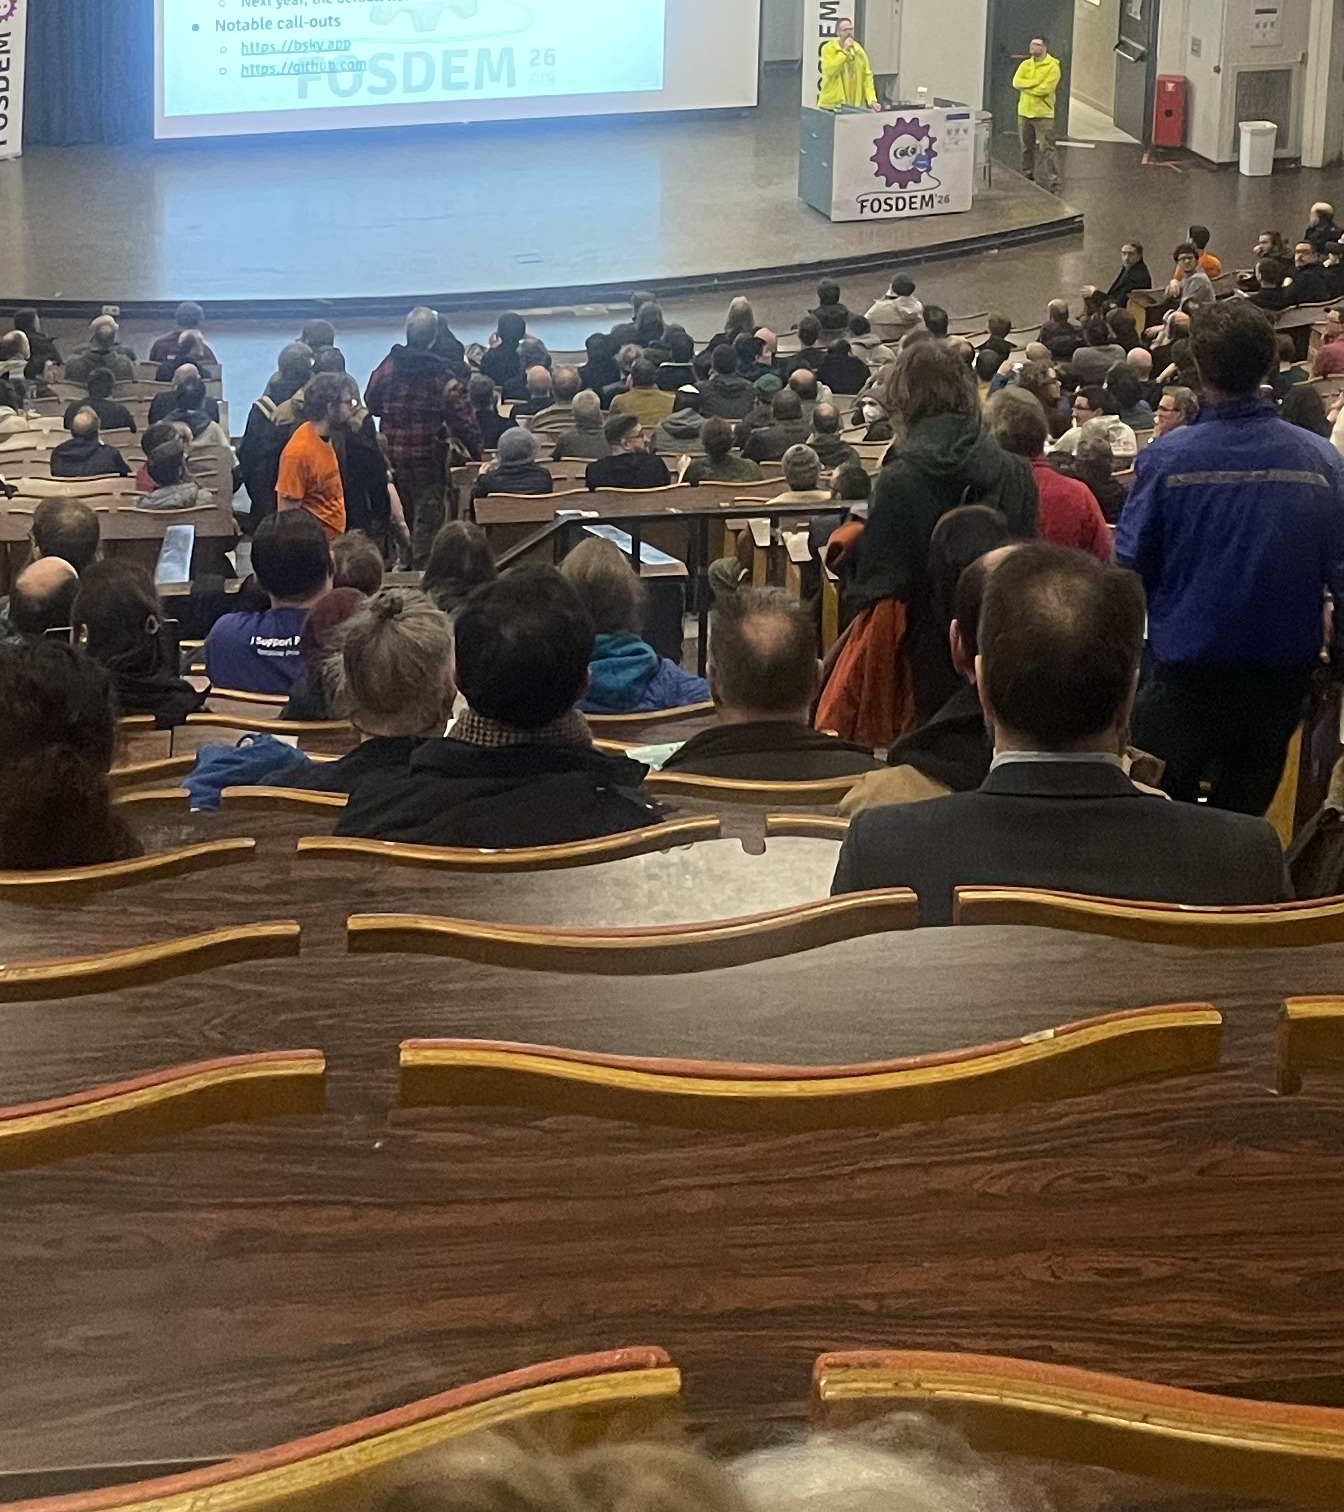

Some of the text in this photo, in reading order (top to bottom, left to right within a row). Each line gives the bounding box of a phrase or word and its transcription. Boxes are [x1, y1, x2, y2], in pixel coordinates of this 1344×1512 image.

[215, 14, 342, 32] Notable call-outs
[297, 47, 556, 100] FOSDEM 26
[859, 193, 935, 215] FOSDEM
